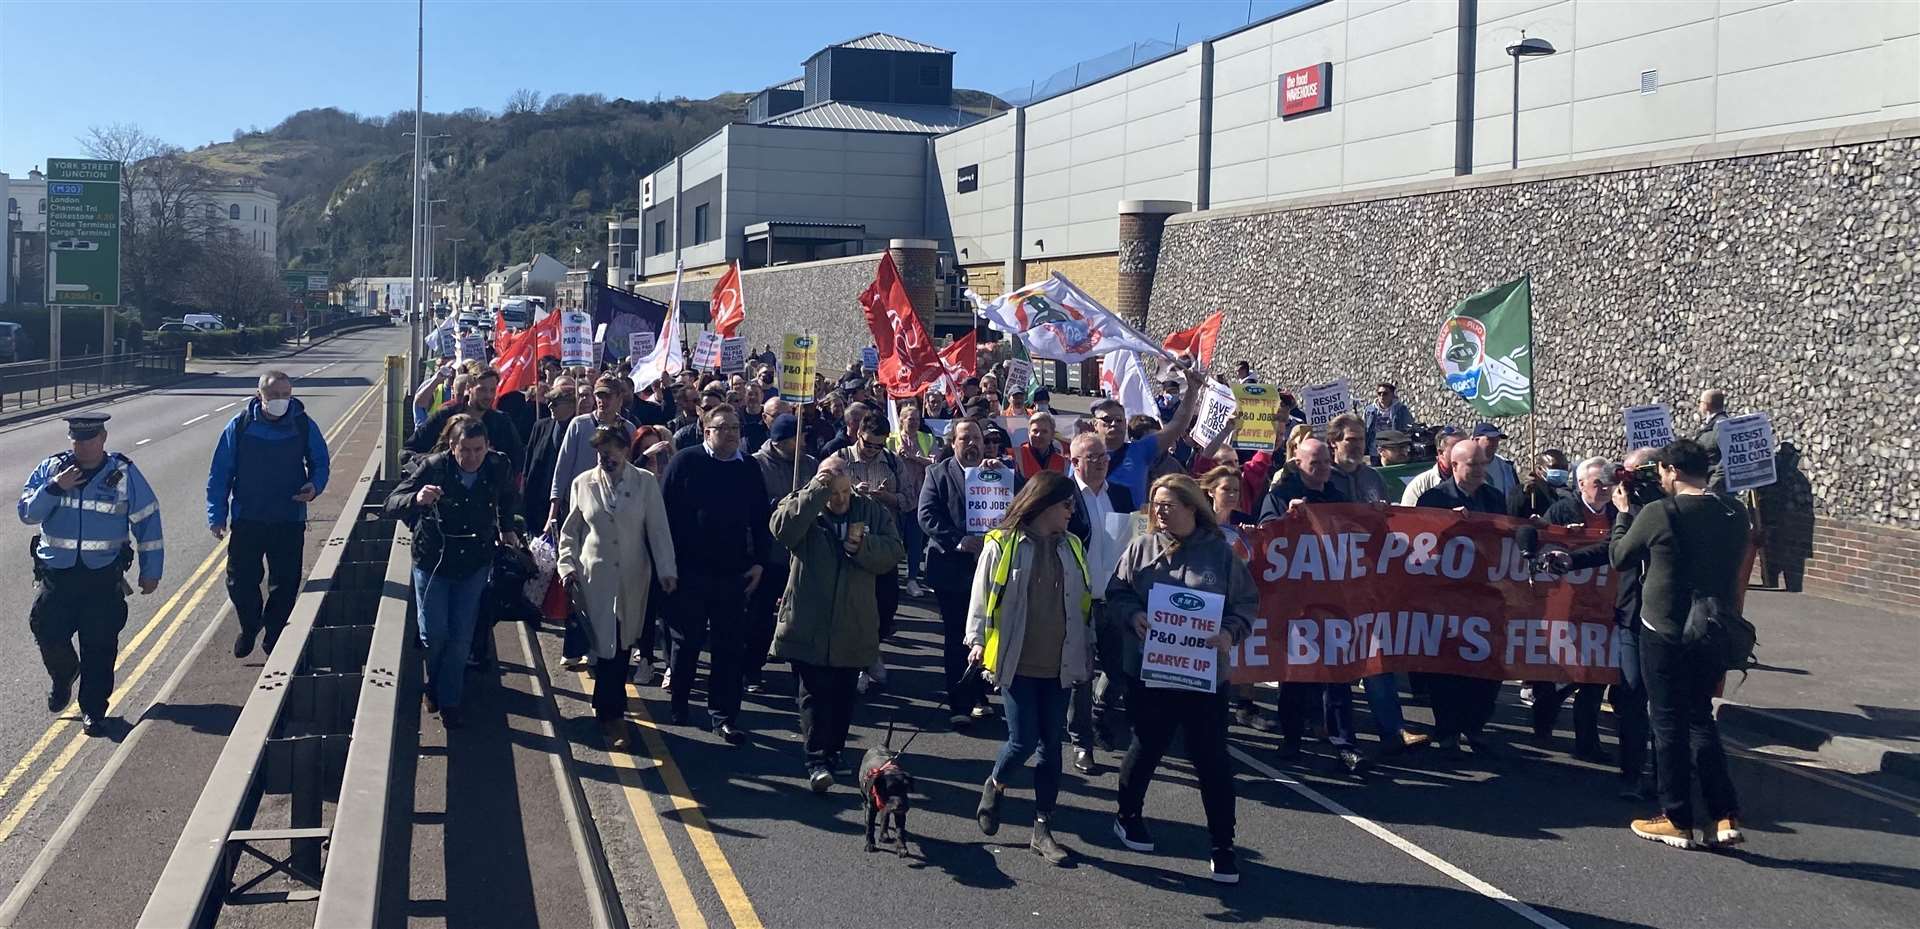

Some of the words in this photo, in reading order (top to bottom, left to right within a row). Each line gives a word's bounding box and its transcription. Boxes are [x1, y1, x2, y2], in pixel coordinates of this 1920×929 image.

[55, 161, 78, 169] YORK
[61, 170, 107, 178] JUNCTION
[50, 204, 83, 212] Channel
[86, 204, 98, 212] Tnl
[50, 212, 95, 220] Folkestone
[78, 221, 117, 229] Terminals
[50, 228, 75, 237] Cargo
[78, 229, 111, 237] Terminal
[783, 364, 801, 375] P&O
[1312, 392, 1342, 407] RESIST
[1208, 398, 1232, 417] SAVE
[1311, 406, 1327, 416] ALL
[1328, 401, 1346, 413] P&O
[1208, 408, 1226, 424] P&O
[1238, 410, 1255, 420] P&O
[1310, 415, 1327, 425] JOB
[1203, 417, 1225, 433] JOBS
[1633, 417, 1665, 430] RESIST
[1632, 430, 1649, 441] ALL
[1650, 427, 1669, 438] P&O
[1730, 427, 1764, 443] RESIST
[1728, 442, 1748, 455] ALL
[1748, 438, 1769, 451] P&O
[1727, 453, 1747, 466] JOB
[1748, 447, 1772, 462] CUTS
[969, 486, 992, 496] STOP
[994, 487, 1010, 497] THE
[968, 500, 988, 510] P&O
[968, 517, 998, 528] CARVE
[1263, 532, 1372, 582] SAVE
[1376, 531, 1476, 580] P&O
[1177, 596, 1201, 608] RMT
[1153, 610, 1188, 628] STOP
[1190, 616, 1216, 633] THE
[1148, 628, 1177, 645] P&O
[1287, 610, 1492, 666] BRITAIN'S
[1146, 651, 1190, 670] CARVE
[1193, 657, 1212, 673] UP
